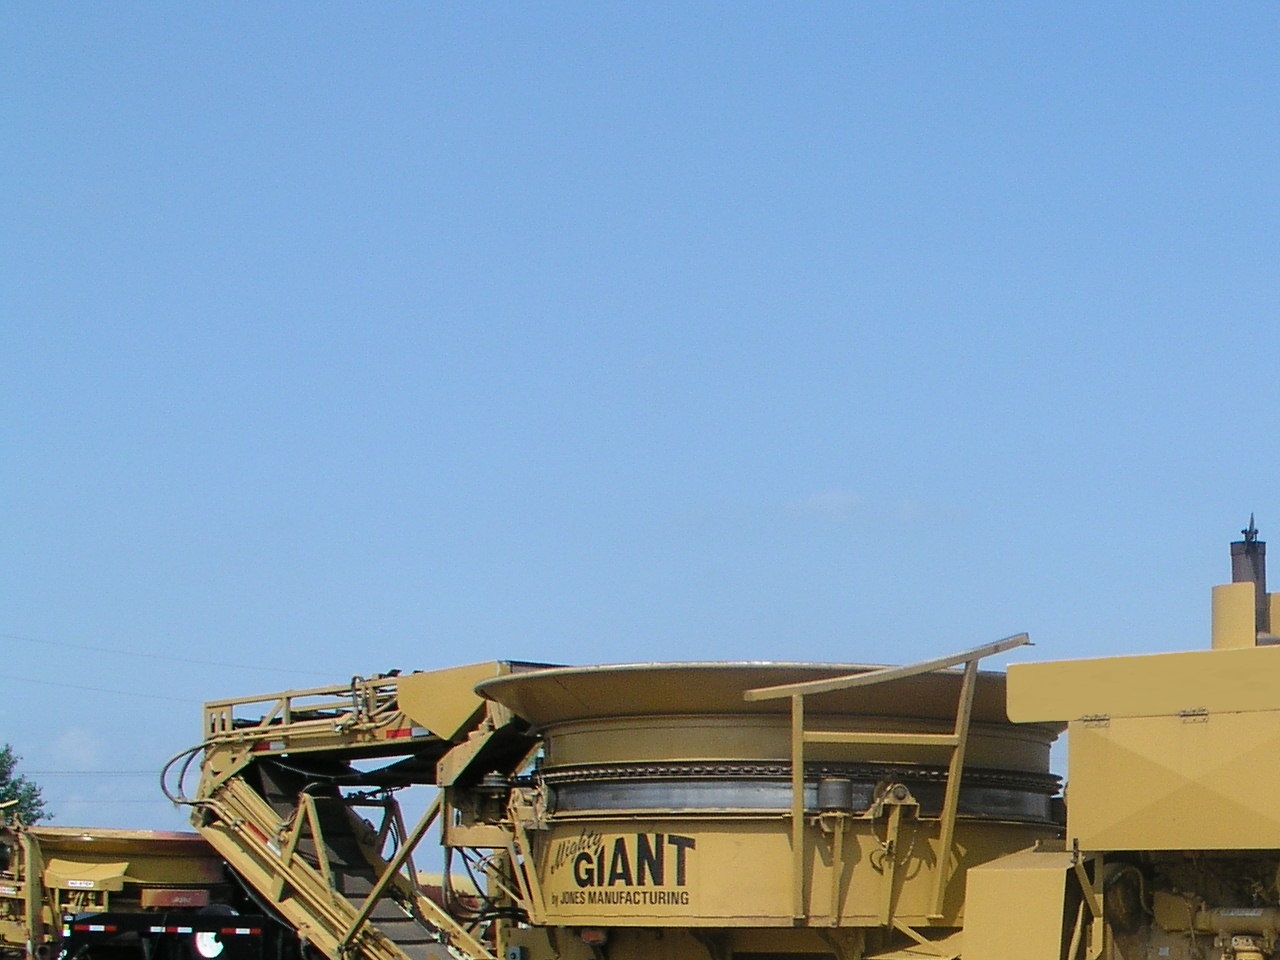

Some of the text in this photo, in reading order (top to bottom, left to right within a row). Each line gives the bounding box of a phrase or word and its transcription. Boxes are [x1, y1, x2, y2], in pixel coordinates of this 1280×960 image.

[550, 827, 602, 875] Mighty
[574, 833, 696, 888] GIANT
[551, 891, 689, 908] by JONES MANUFACTURING
